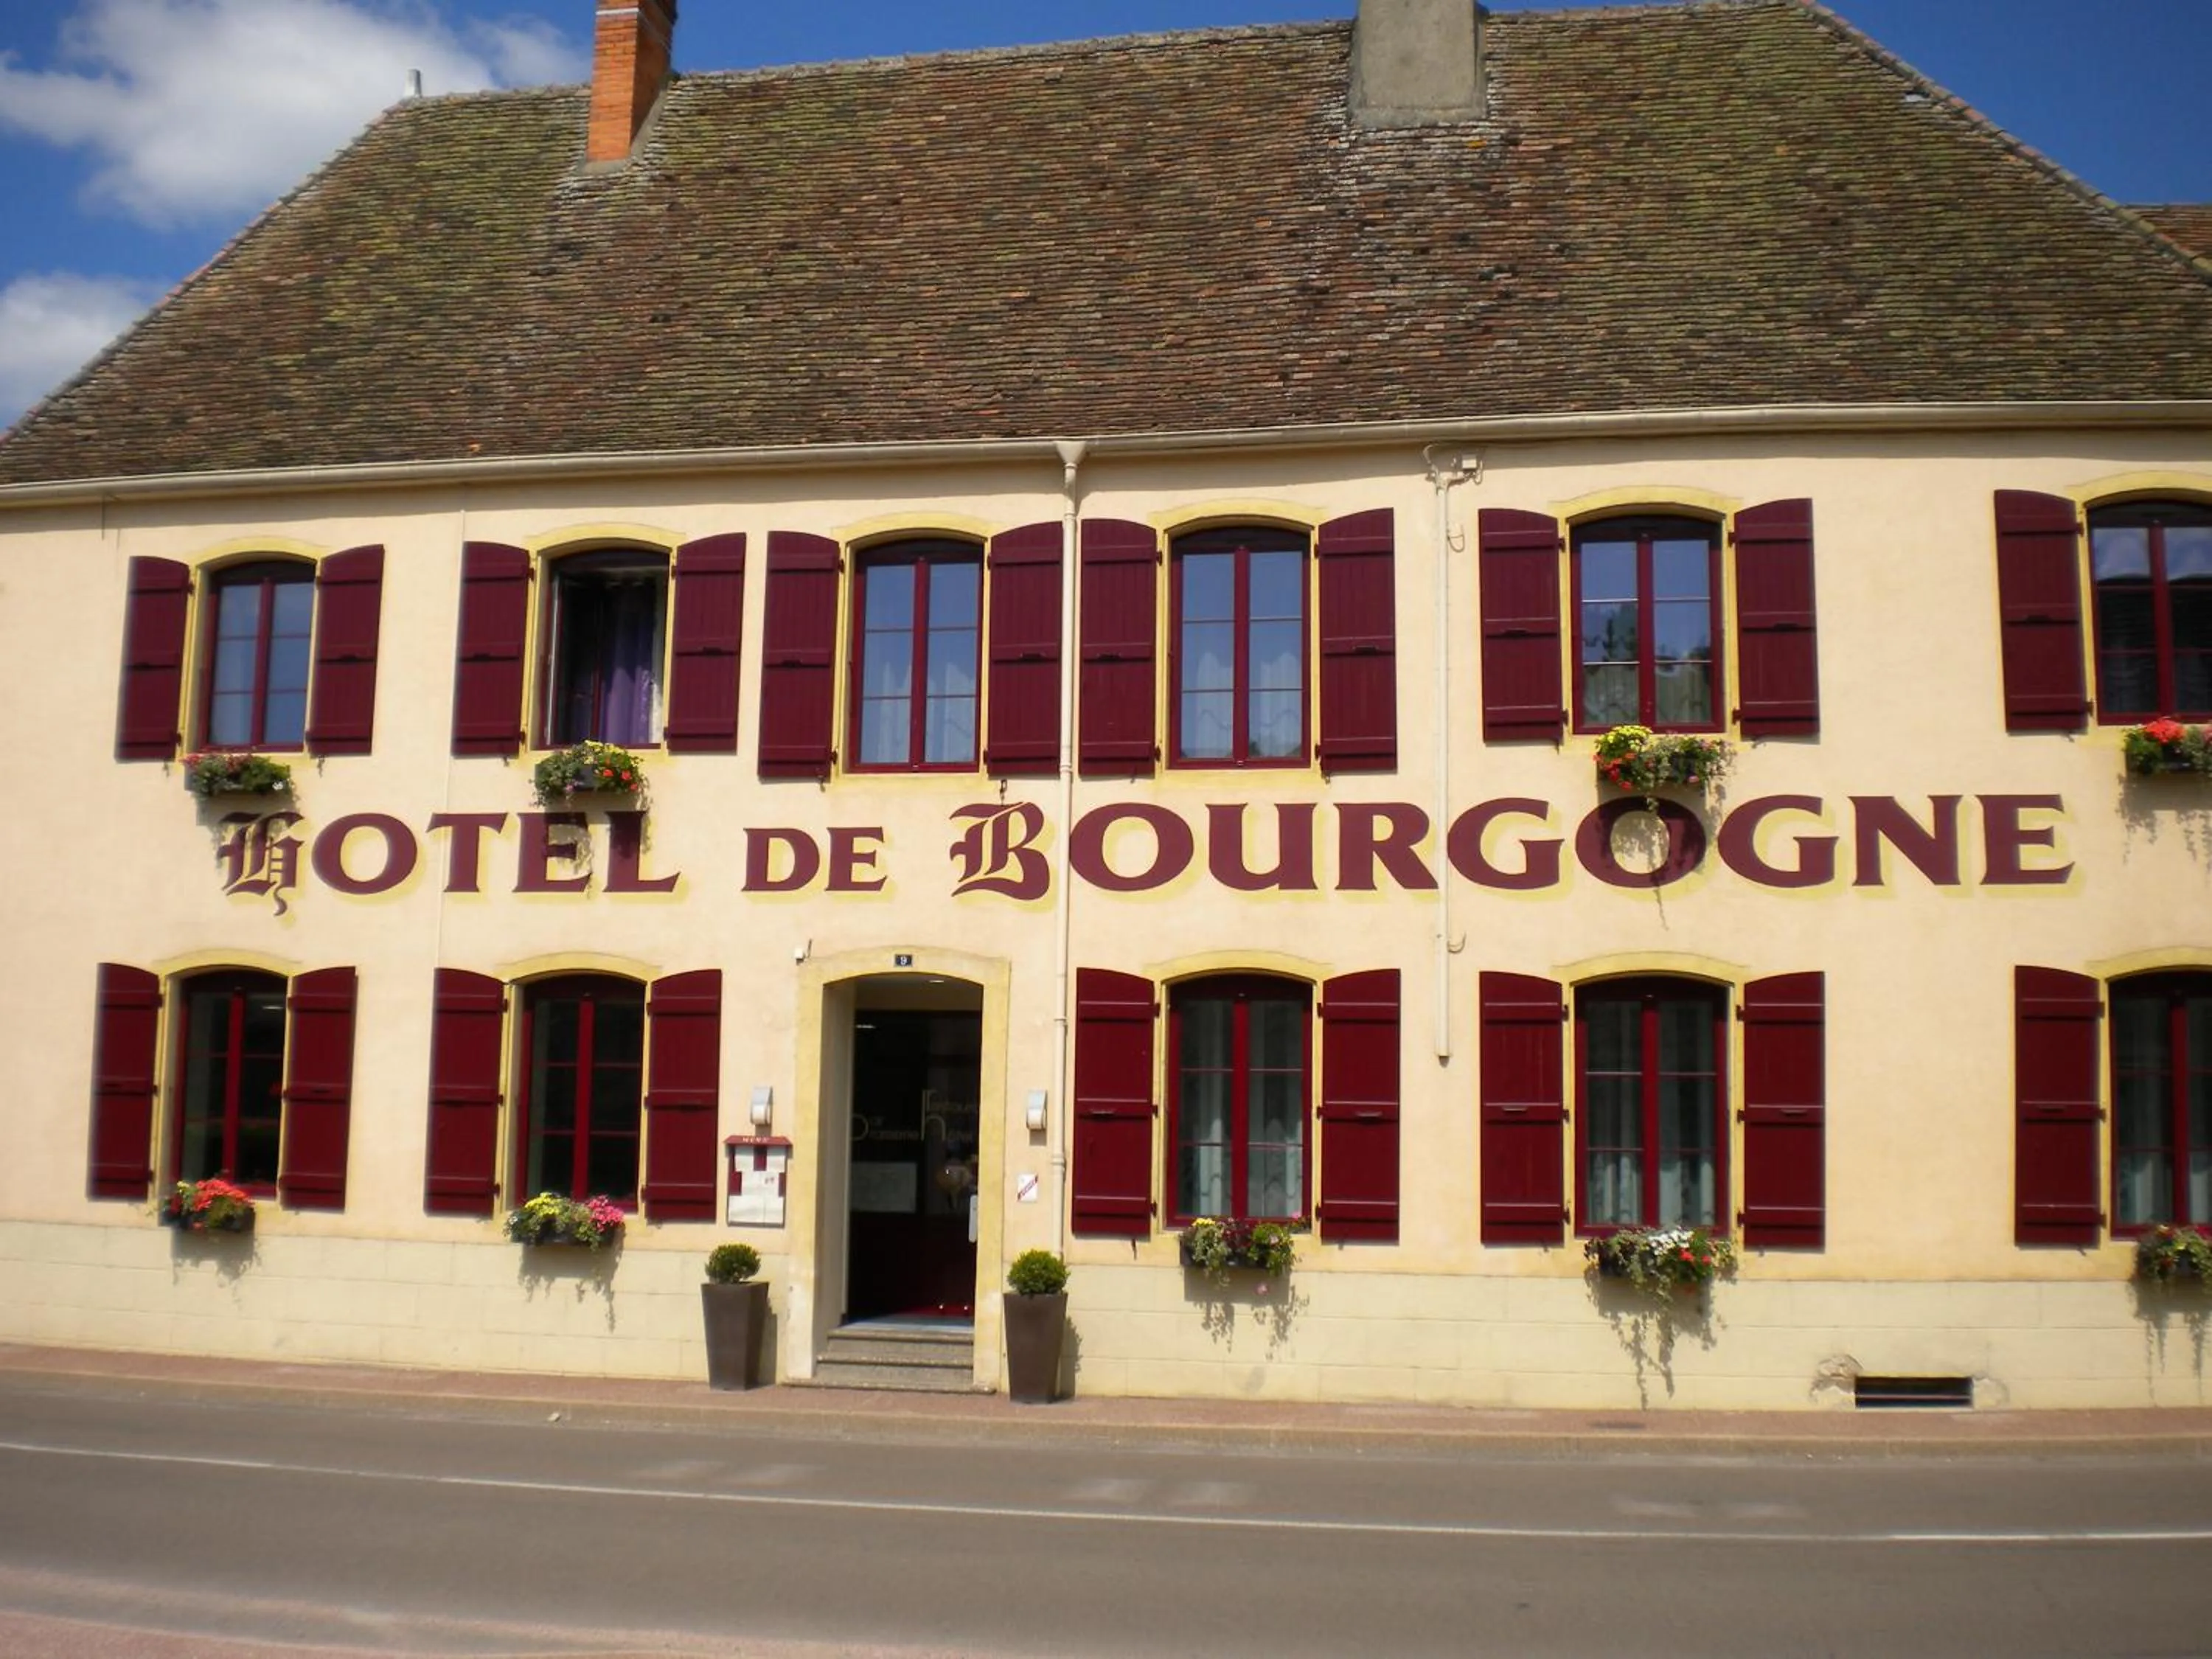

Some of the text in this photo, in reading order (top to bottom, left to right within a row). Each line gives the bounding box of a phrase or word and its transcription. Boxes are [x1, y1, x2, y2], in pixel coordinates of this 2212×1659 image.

[217, 794, 2076, 916] HOTEL DE BOURGOGNE
